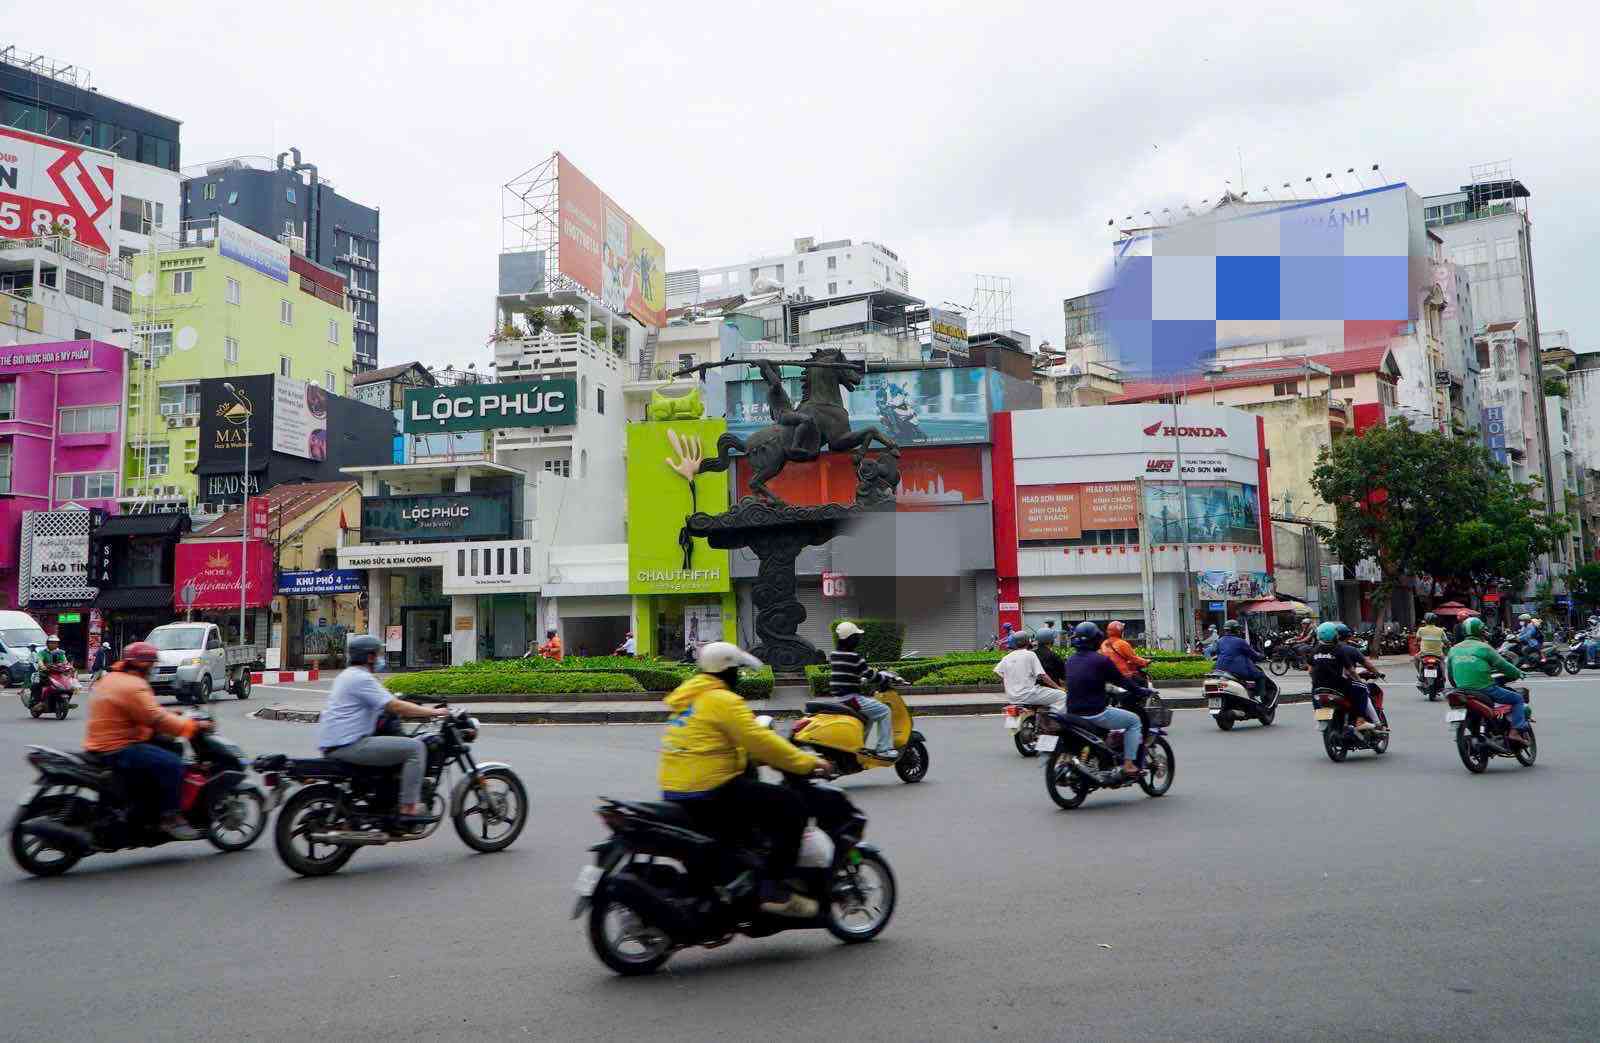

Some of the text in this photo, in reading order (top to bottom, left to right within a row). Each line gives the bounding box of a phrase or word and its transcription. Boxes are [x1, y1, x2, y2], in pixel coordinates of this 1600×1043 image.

[411, 386, 566, 425] LỘC PHÚC
[1163, 427, 1228, 437] HONDA
[207, 475, 239, 495] HEAD
[402, 503, 470, 522] LỘC PHÚC
[296, 577, 314, 586] KHU
[316, 573, 334, 585] PHỐ
